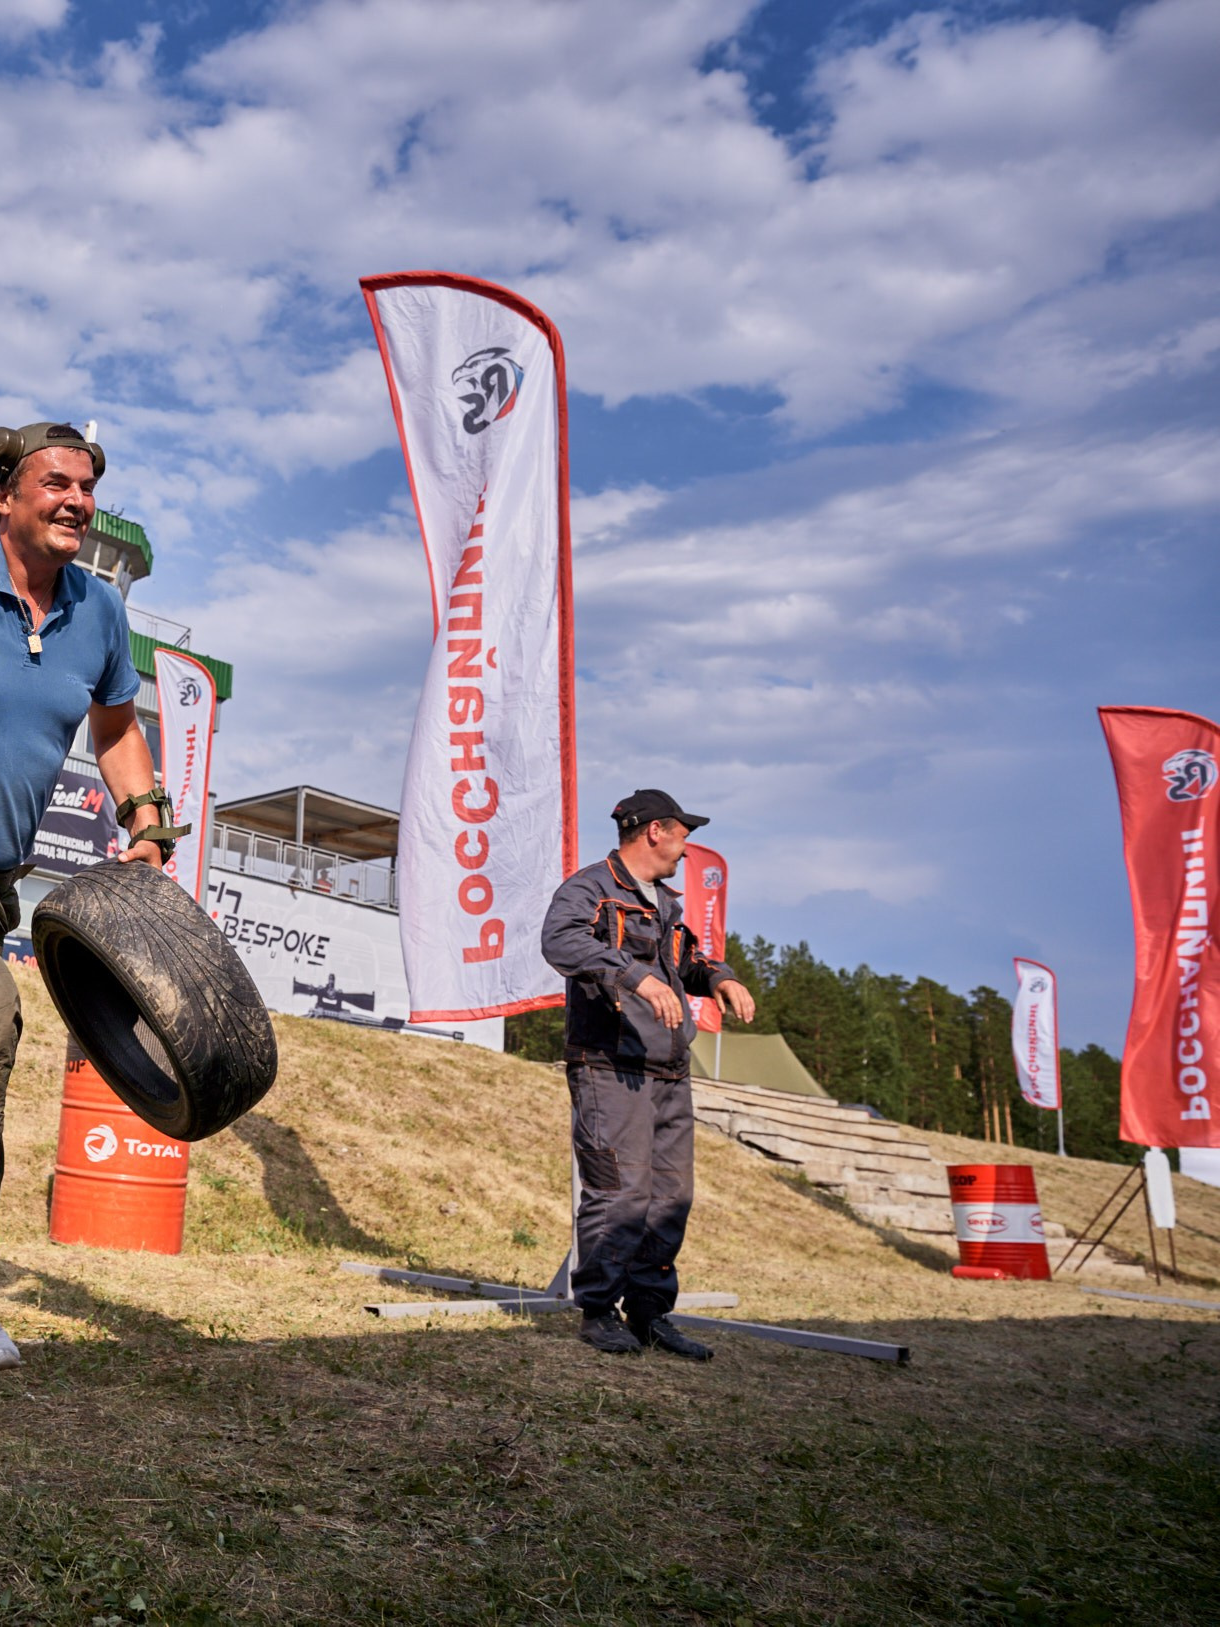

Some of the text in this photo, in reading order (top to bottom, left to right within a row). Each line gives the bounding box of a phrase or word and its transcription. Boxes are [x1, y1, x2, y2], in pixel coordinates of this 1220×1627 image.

[50, 783, 105, 813] real-M
[33, 842, 56, 860] УХОД
[56, 847, 67, 860] ЗА
[35, 830, 94, 854] КОМПЛЕКСНЫЙ
[223, 914, 330, 959] BESPOKE
